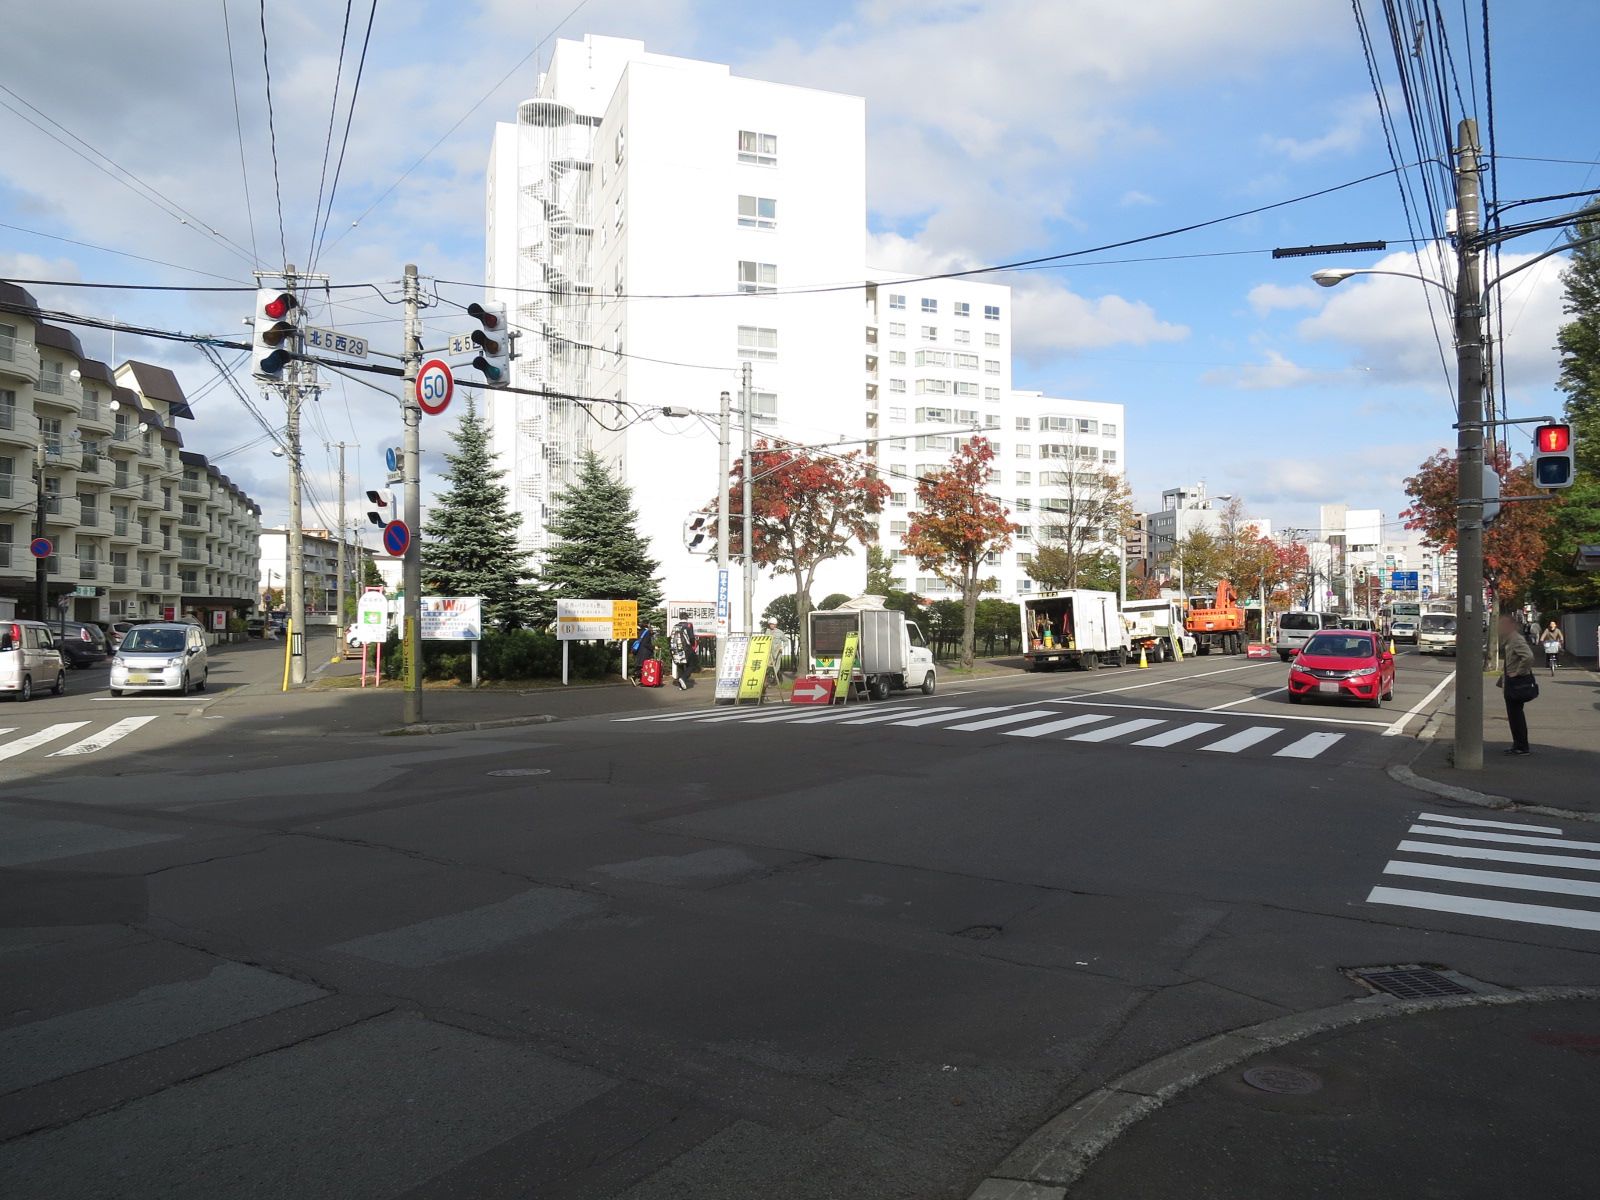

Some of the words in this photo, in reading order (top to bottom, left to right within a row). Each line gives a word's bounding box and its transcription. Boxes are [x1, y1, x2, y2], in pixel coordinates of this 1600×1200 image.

[310, 330, 363, 355] 北5西29
[424, 374, 445, 400] 50
[747, 642, 766, 690] 工事中
[840, 646, 854, 681] 徐行
